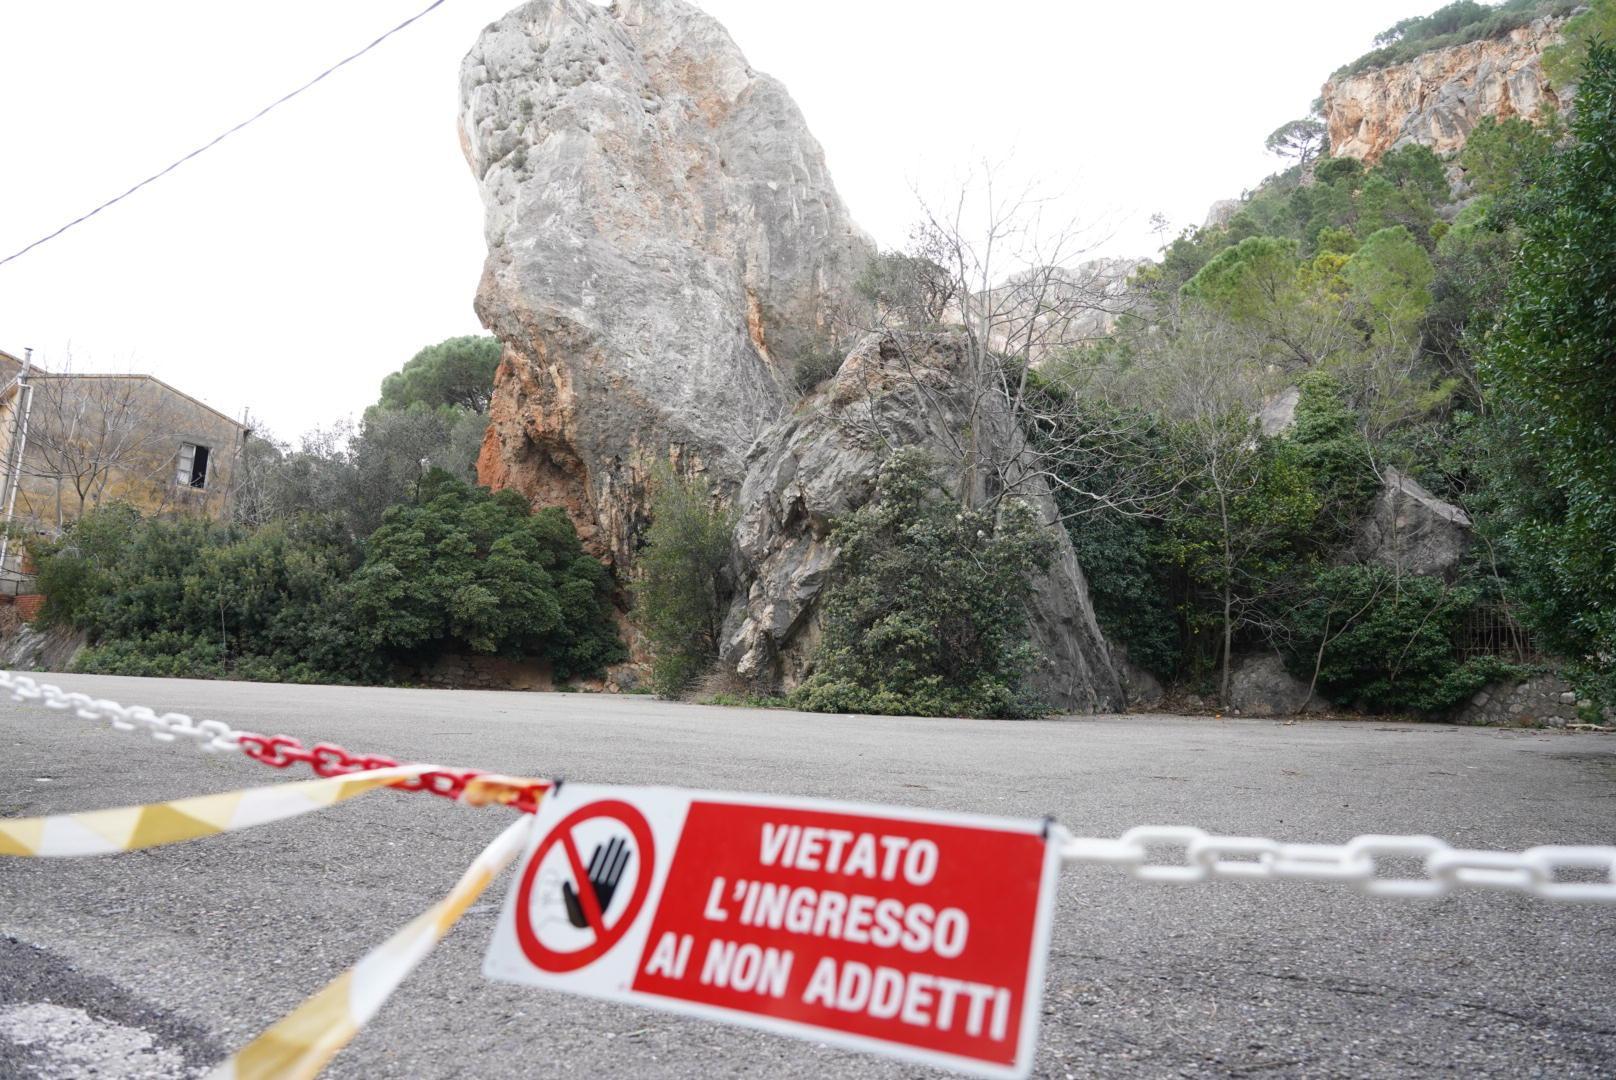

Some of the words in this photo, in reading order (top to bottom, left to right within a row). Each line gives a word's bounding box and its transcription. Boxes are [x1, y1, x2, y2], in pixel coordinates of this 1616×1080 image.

[759, 822, 938, 885] VIETATO
[704, 877, 968, 957] L'INGRESSO
[645, 932, 694, 979] AI
[701, 940, 793, 998] NON
[802, 957, 1011, 1041] ADDETTI
